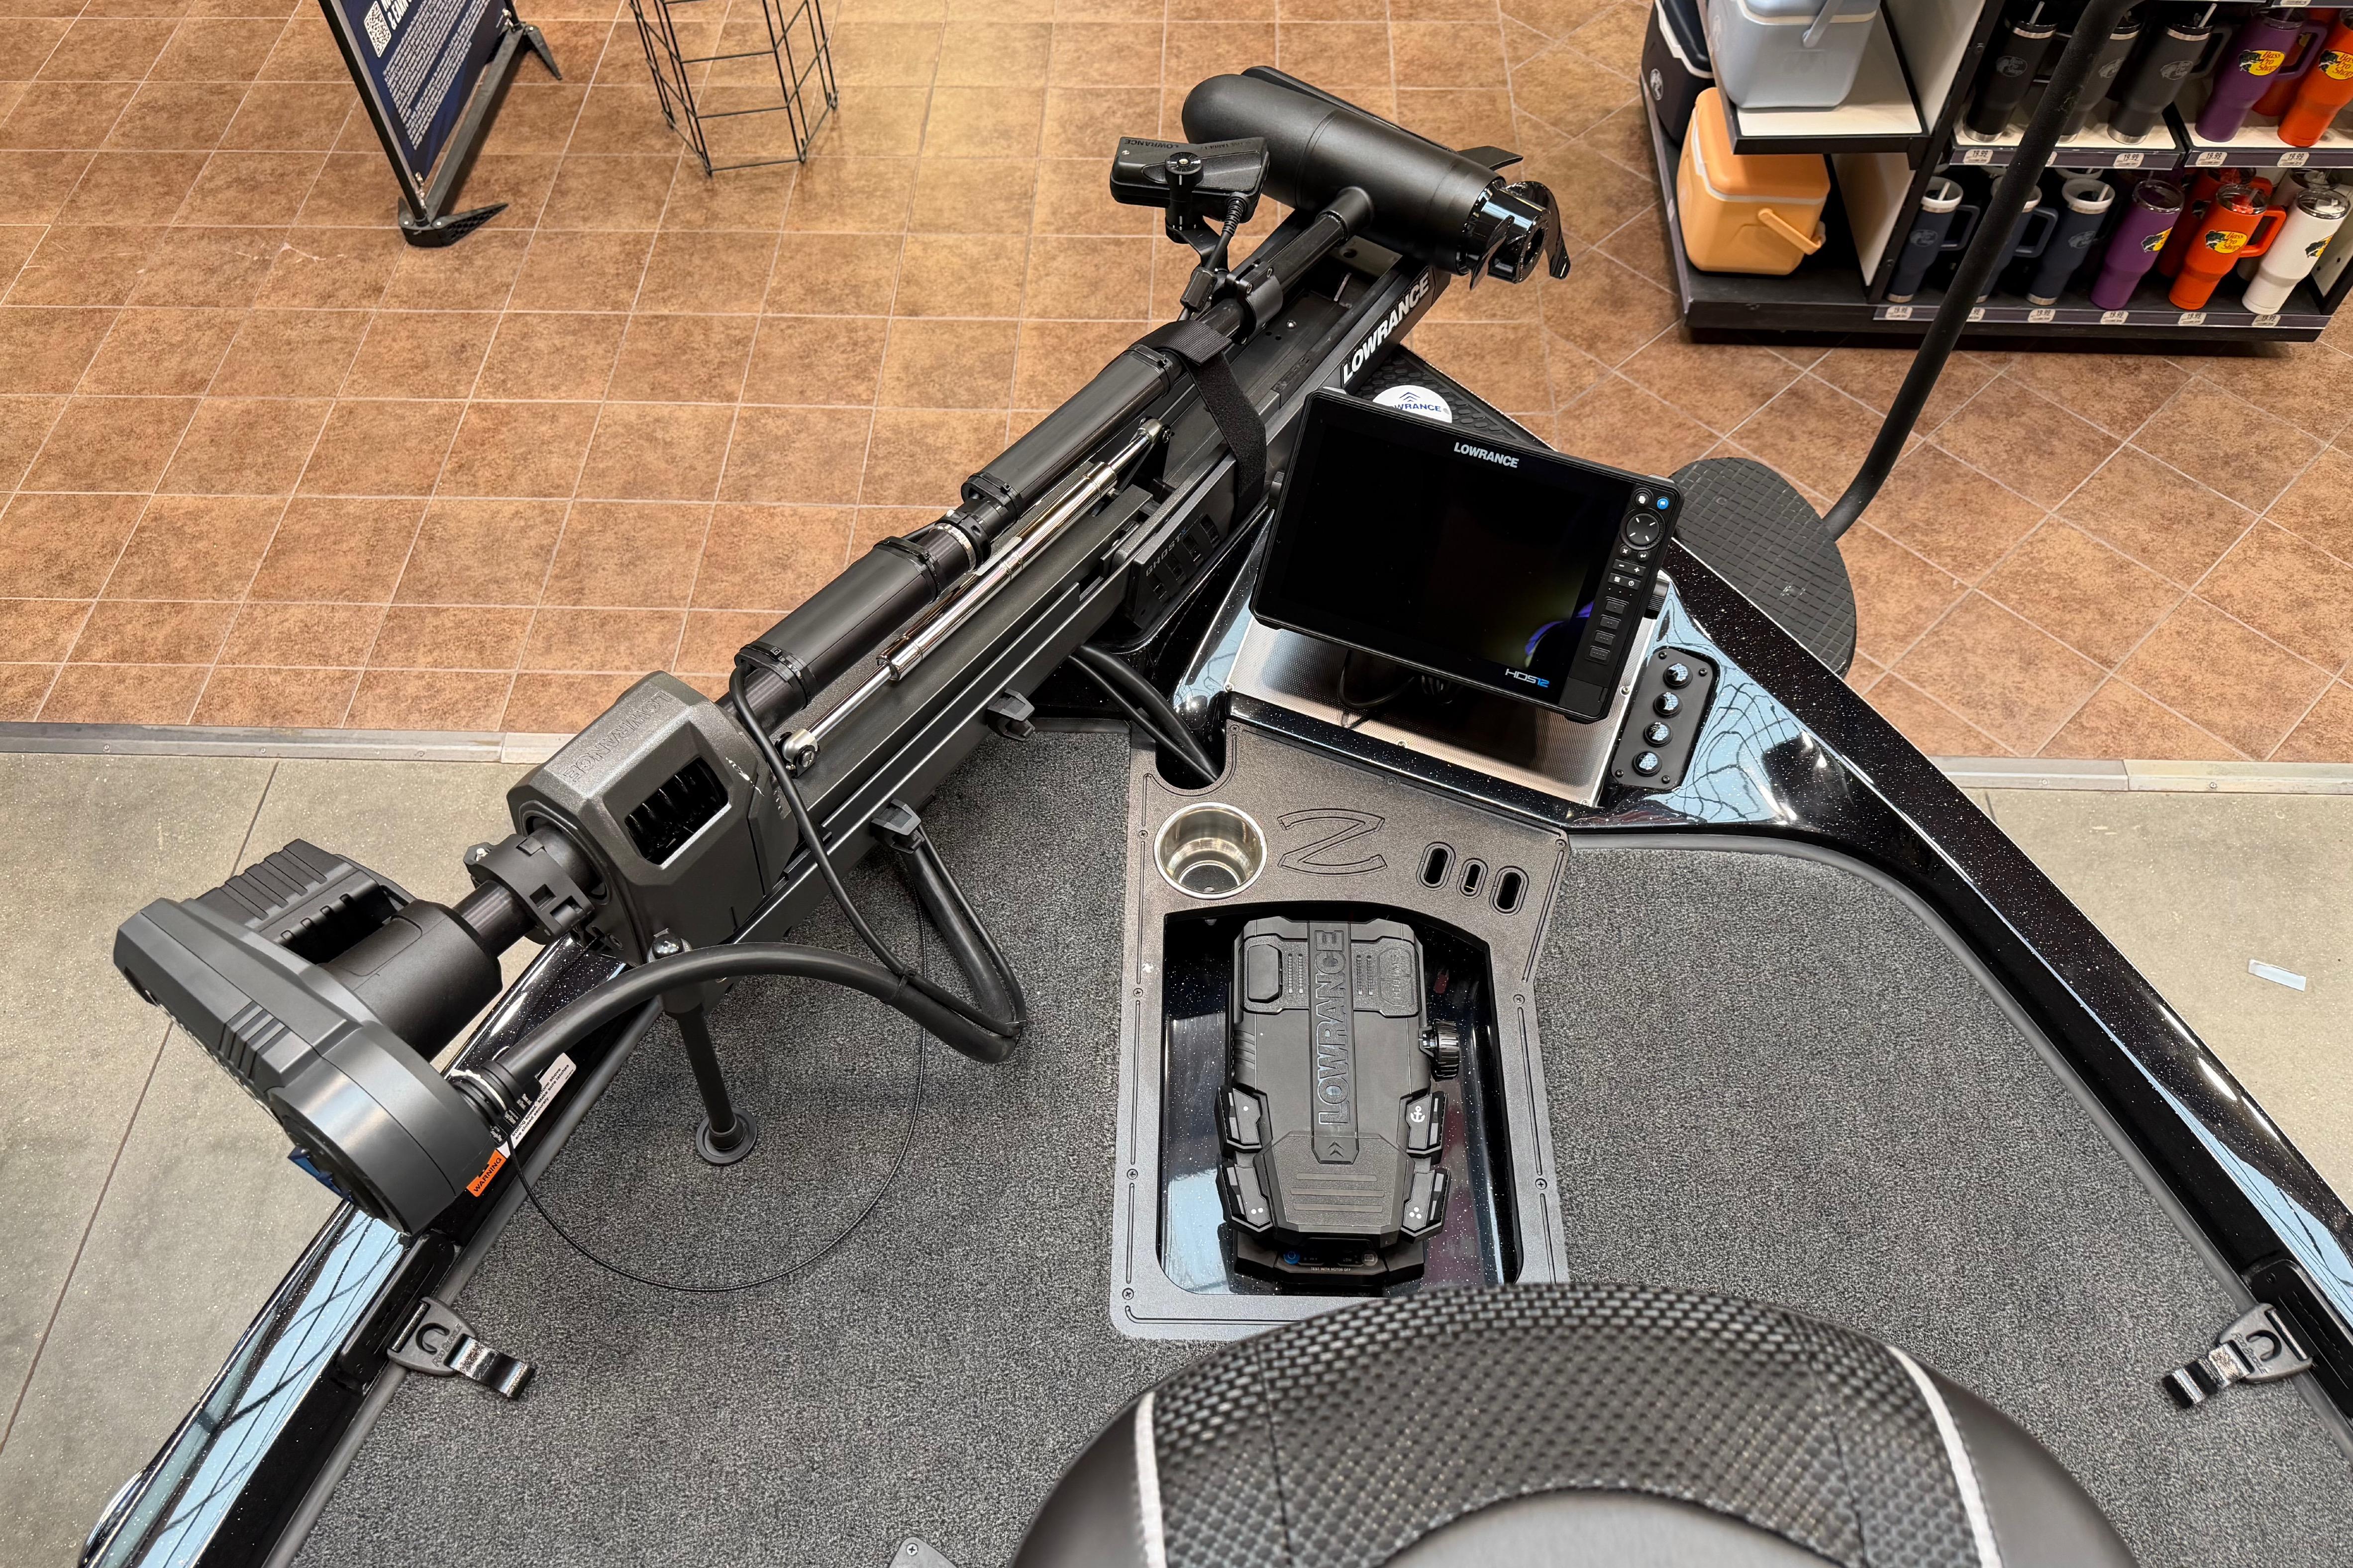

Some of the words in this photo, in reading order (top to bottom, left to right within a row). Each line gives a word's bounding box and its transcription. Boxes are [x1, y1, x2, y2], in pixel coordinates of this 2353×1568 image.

[1344, 272, 1429, 385] LOWRANCE
[1394, 403, 1441, 412] WRANCE
[1454, 442, 1520, 468] LOWRANCE
[562, 690, 673, 783] LOWRANCE
[1315, 930, 1350, 1125] LOWRANCE
[549, 1068, 561, 1081] above
[512, 1120, 526, 1137] trolling
[537, 1090, 548, 1103] Make
[548, 1080, 556, 1091] sure
[556, 1064, 569, 1080] latches
[521, 1115, 534, 1132] closed
[473, 1157, 502, 1192] WARNING
